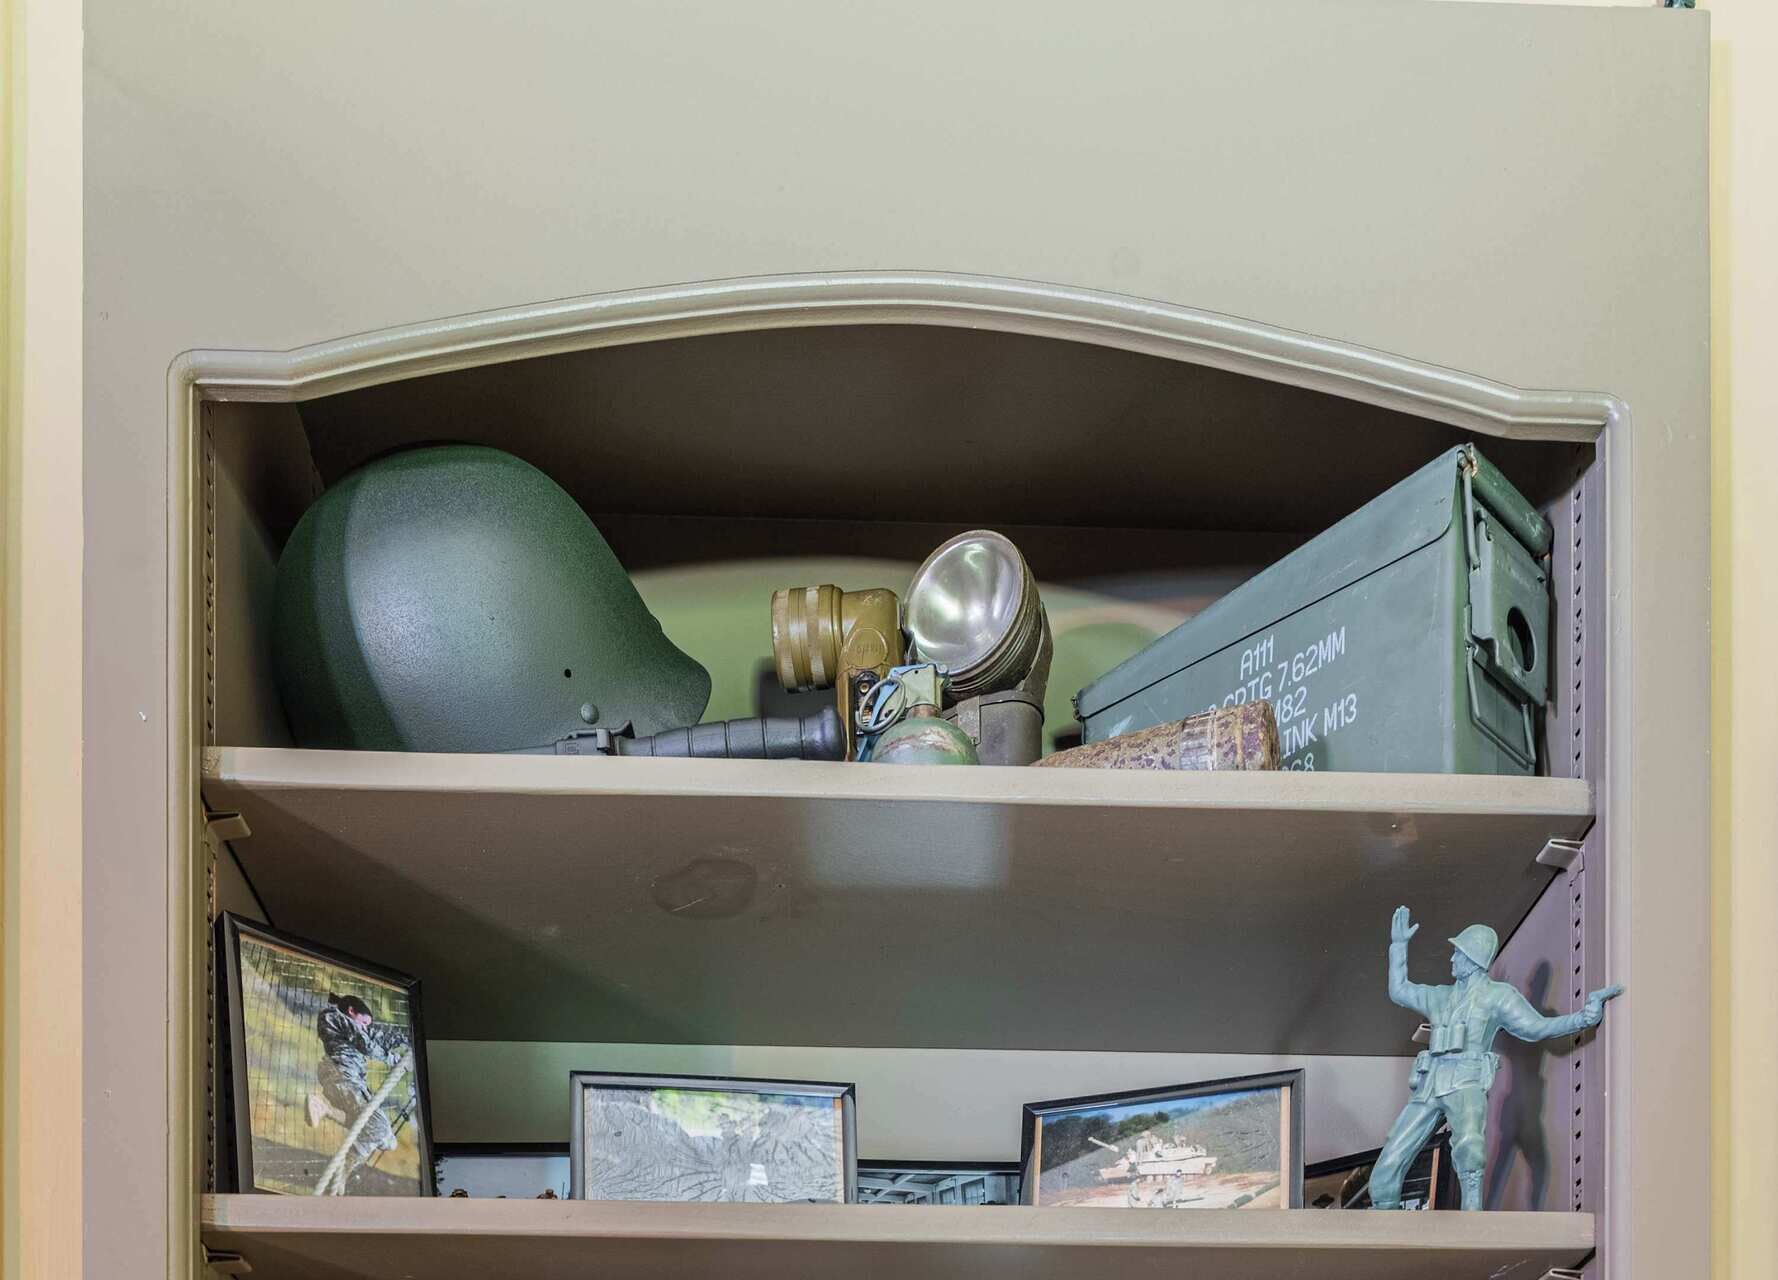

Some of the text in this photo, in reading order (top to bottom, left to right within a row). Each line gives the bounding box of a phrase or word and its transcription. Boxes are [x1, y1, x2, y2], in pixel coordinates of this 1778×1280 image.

[1240, 634, 1274, 680] A111
[1277, 626, 1345, 692] 7.62MM
[1281, 693, 1357, 760] INK M13
